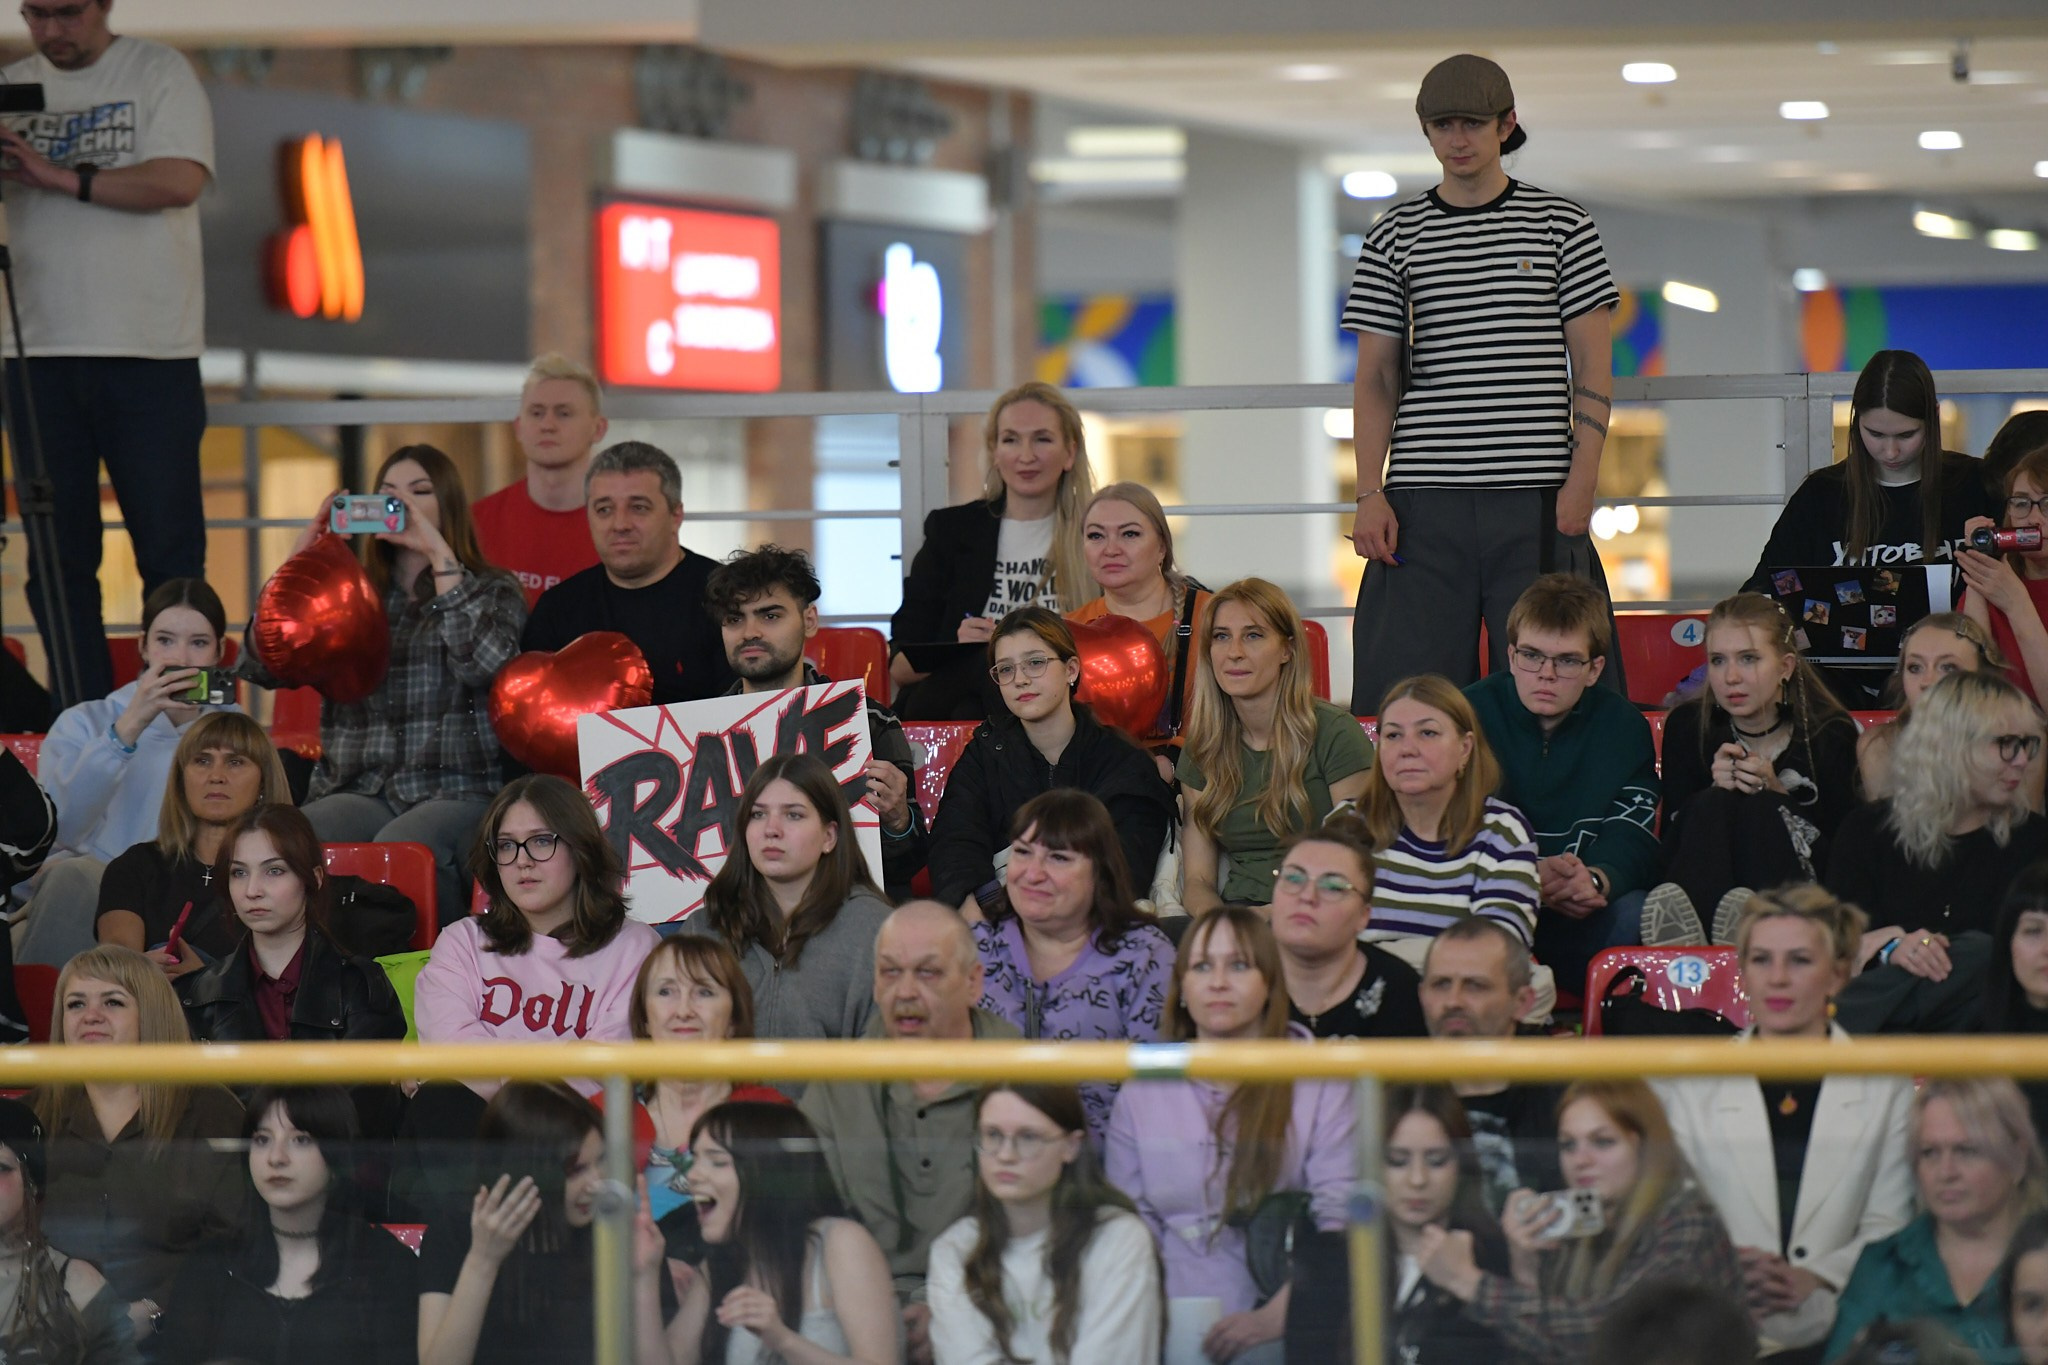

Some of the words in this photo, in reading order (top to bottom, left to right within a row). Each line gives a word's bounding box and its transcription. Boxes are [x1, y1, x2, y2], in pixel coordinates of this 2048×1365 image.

[1682, 623, 1696, 642] 4
[1673, 961, 1702, 983] 13
[480, 976, 596, 1039] Doll
